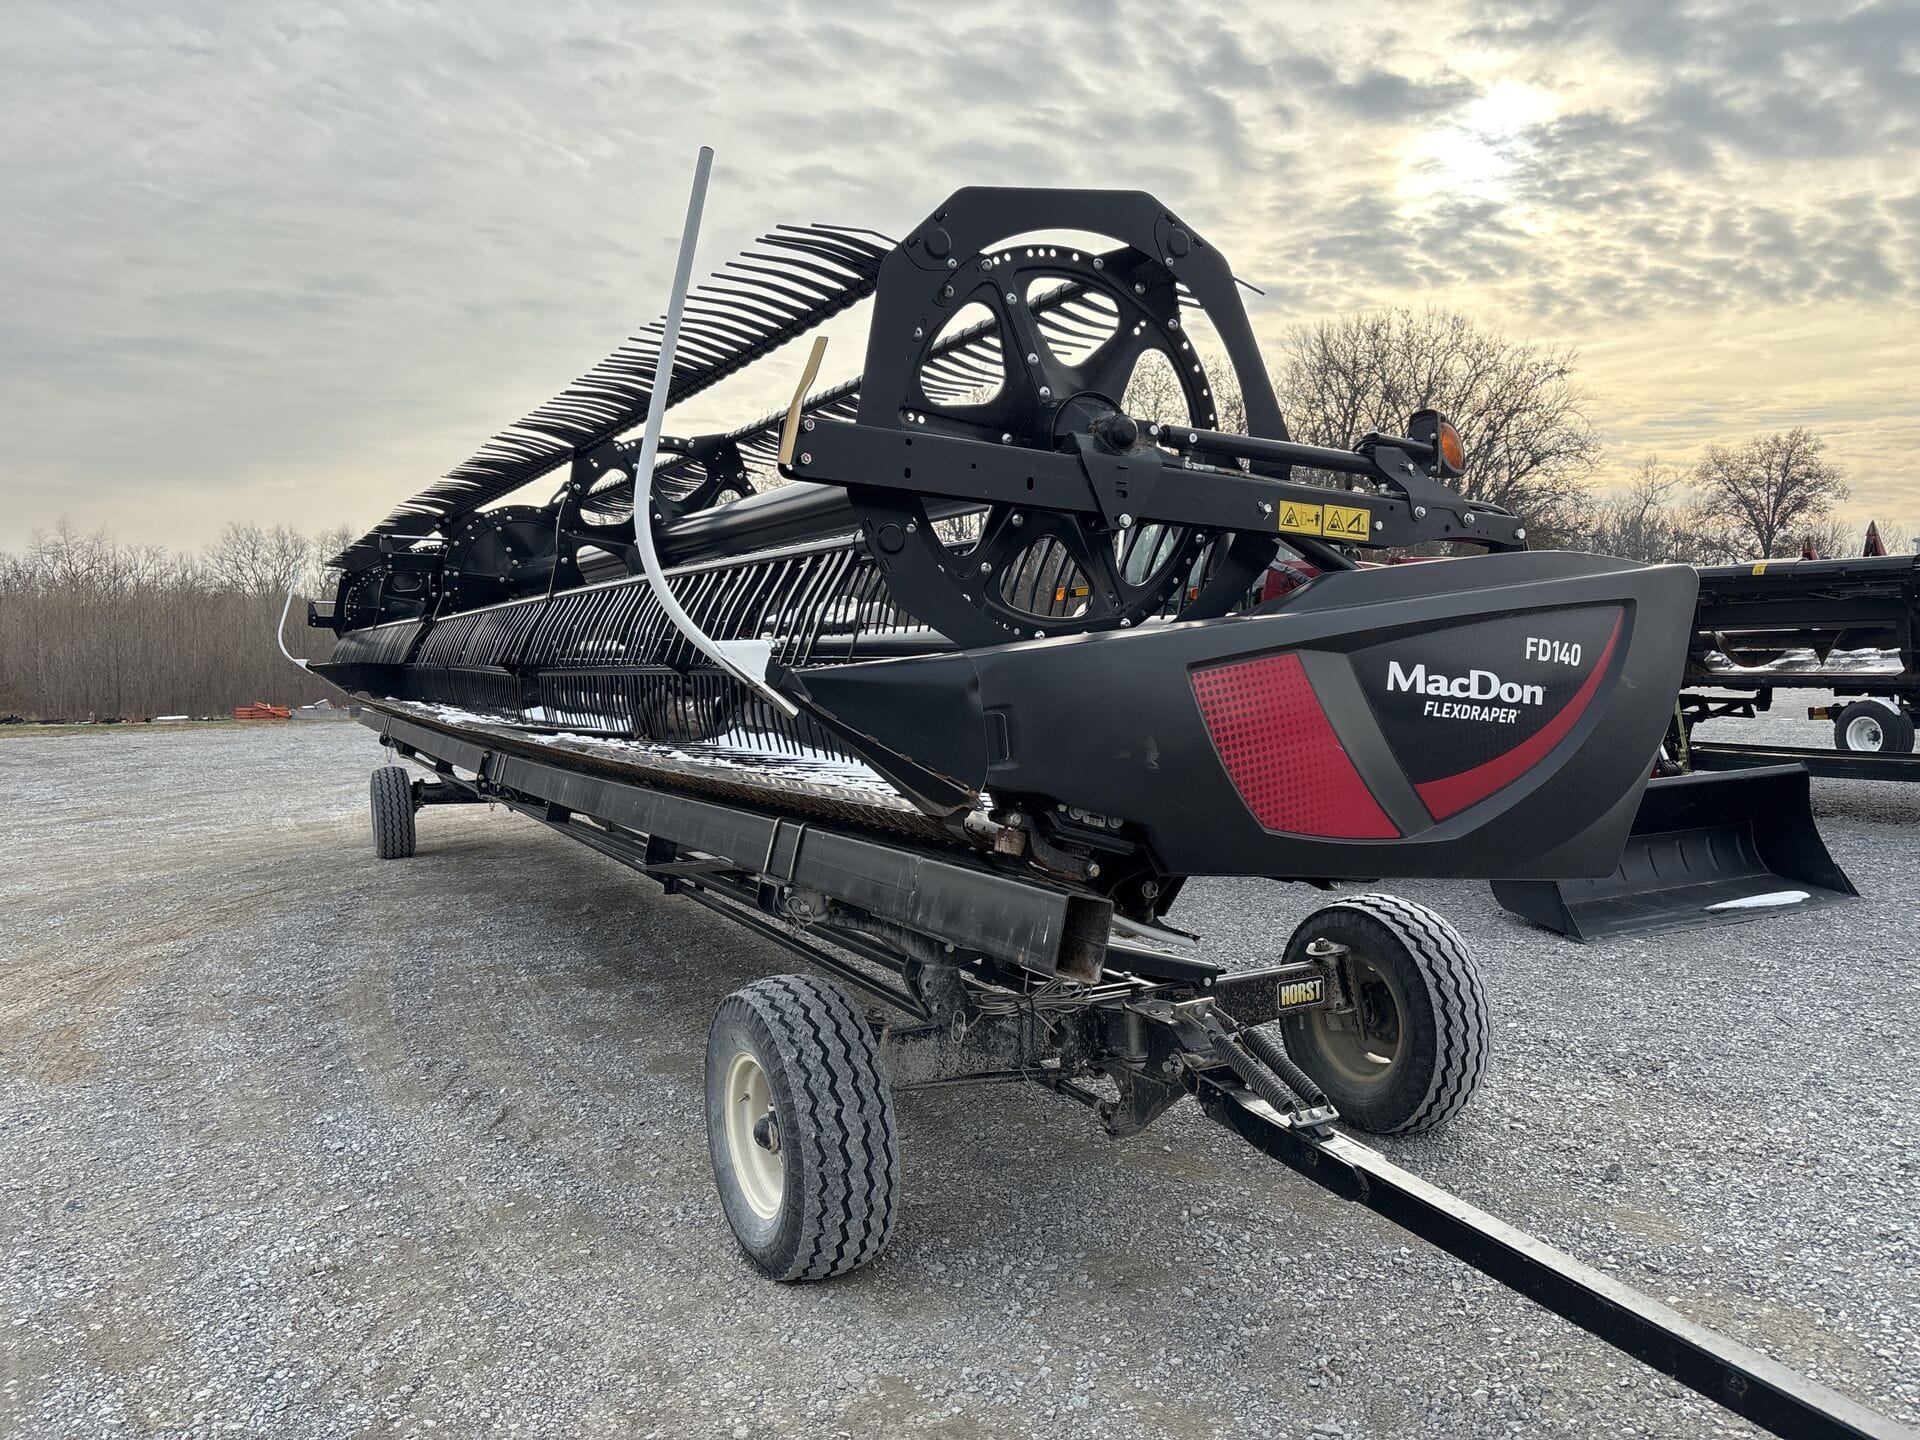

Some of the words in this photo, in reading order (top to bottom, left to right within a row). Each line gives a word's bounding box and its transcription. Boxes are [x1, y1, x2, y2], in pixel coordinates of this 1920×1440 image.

[1525, 636, 1582, 667] FD140
[1387, 661, 1544, 706] MacDon
[1423, 701, 1518, 724] FLEXDRAPER
[1280, 980, 1322, 1006] HORST
